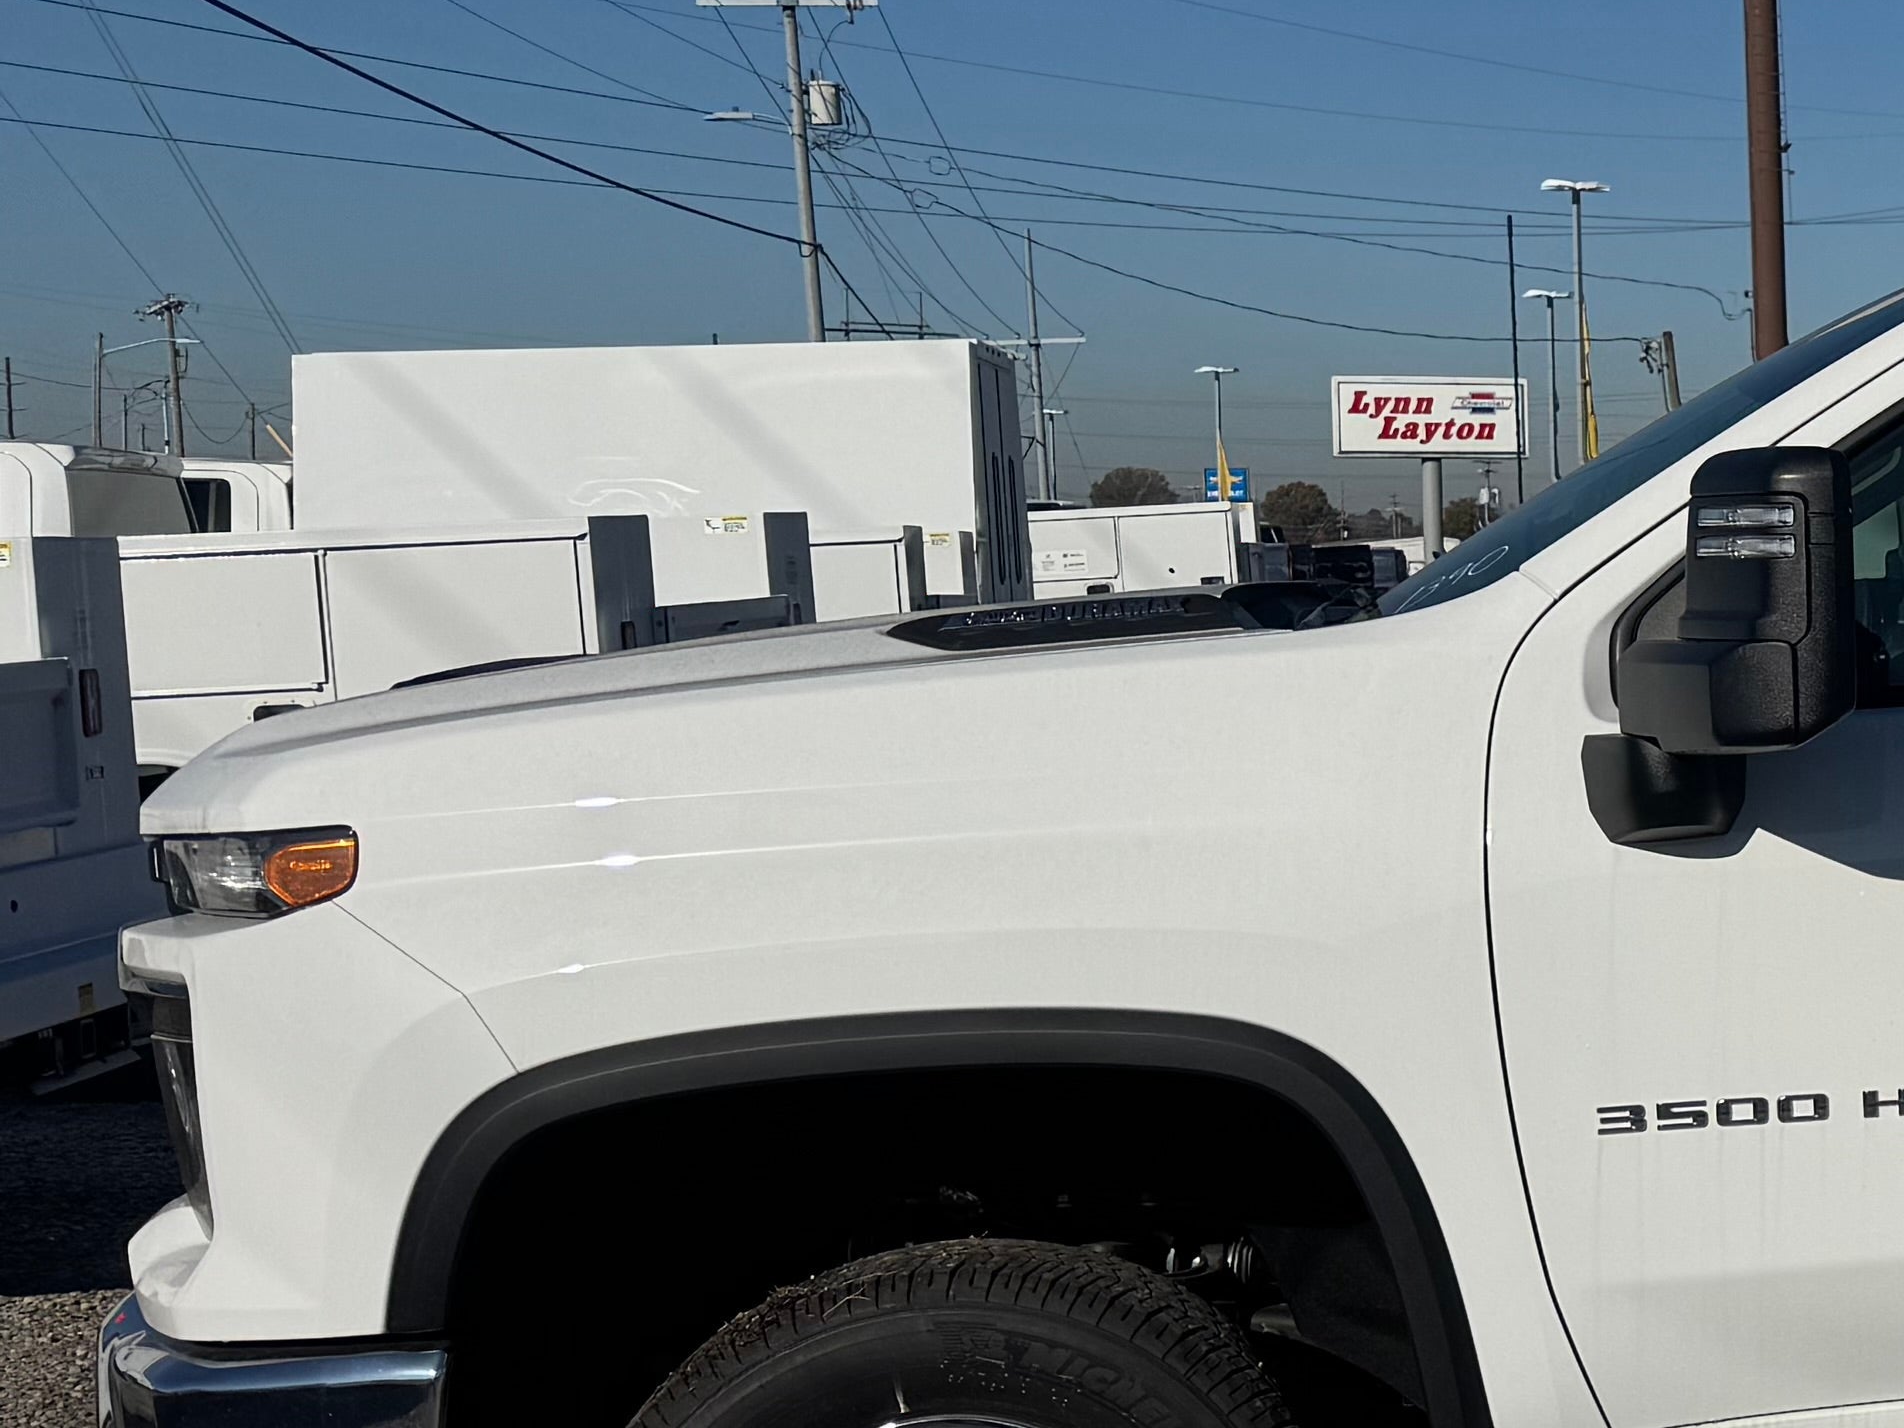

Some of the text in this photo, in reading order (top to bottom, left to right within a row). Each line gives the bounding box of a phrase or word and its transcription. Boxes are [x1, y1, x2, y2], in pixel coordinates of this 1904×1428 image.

[1347, 390, 1434, 419] Lynn
[1378, 416, 1497, 445] Layton
[1597, 1093, 1830, 1136] 3500
